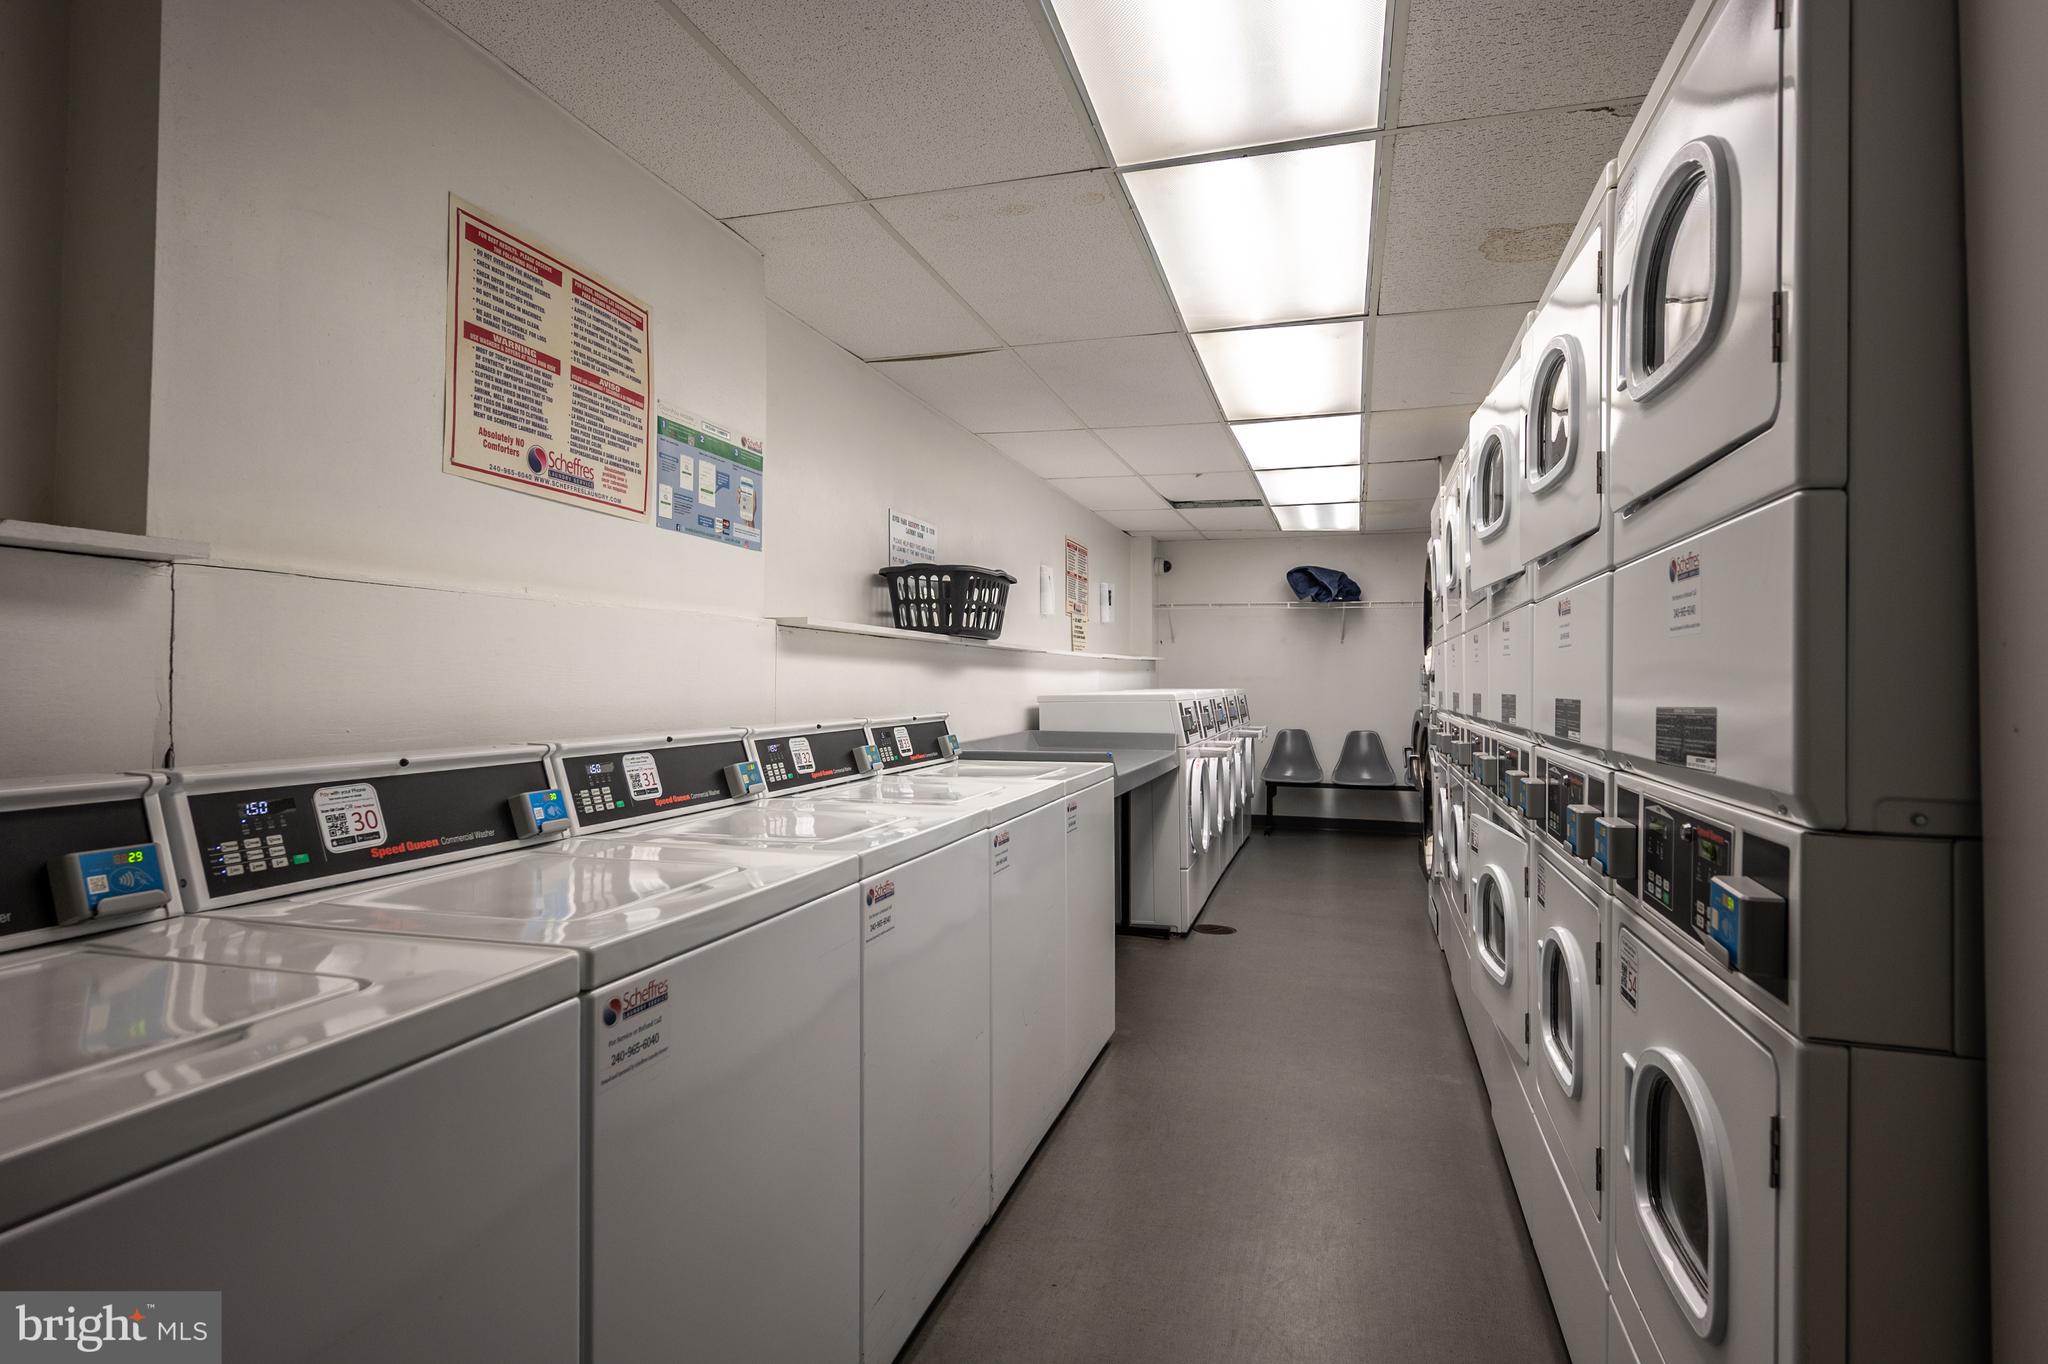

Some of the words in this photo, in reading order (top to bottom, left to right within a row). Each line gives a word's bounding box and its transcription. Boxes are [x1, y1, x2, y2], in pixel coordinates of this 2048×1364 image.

[477, 249, 483, 257] DO
[484, 252, 492, 261] NOT
[493, 257, 515, 272] OVERLOAD
[520, 252, 534, 265] PLEASE
[477, 259, 490, 270] CHECK
[492, 266, 505, 278] WATER
[506, 273, 534, 292] TEMPERATURE
[477, 269, 490, 280] CHECK
[491, 276, 504, 287] DRYER
[506, 283, 515, 293] HEAT
[476, 277, 482, 285] NO
[484, 280, 499, 293] DYEING
[506, 290, 523, 304] CLOTHES
[476, 287, 482, 295] DO
[483, 290, 492, 299] NOT
[493, 295, 504, 305] WASH
[476, 297, 492, 310] PLEASE
[493, 305, 505, 316] LEAVE
[506, 311, 526, 325] MACHINES
[476, 308, 483, 316] WE
[484, 311, 492, 320] ARE
[493, 315, 501, 324] NOT
[502, 319, 528, 336] RESPONSIBLE
[483, 318, 501, 330] DAMAGE
[493, 334, 537, 359] WARNING
[475, 361, 496, 375] DAMAGED
[503, 372, 523, 385] IMPROPER
[476, 345, 488, 356] MOST
[513, 360, 533, 373] GARMENTS
[542, 372, 552, 381] MADE
[482, 356, 504, 370] SYNTHETIC
[506, 365, 524, 378] MATERIAL
[525, 373, 533, 381] AND
[475, 370, 494, 382] CLOTHES
[495, 377, 512, 389] WASHED
[518, 386, 531, 396] WATER
[532, 391, 540, 399] THAT
[484, 381, 490, 389] OR
[491, 384, 502, 393] OVER
[600, 378, 621, 393] AVISO
[474, 394, 483, 403] ANY
[484, 397, 494, 406] LOSS
[502, 403, 520, 415] DAMAGE
[526, 411, 544, 423] CLOTHING
[474, 402, 483, 411] NOT
[492, 408, 525, 425] RESPONSIBILITY
[507, 397, 513, 405] OR
[514, 400, 529, 411] CHANGE
[474, 410, 486, 420] MENT
[494, 417, 518, 430] SCHEFFRES
[519, 425, 536, 436] LAUNDRY
[479, 427, 514, 445] Absolutely
[516, 439, 524, 447] NO
[483, 440, 520, 457] Comforters
[700, 435, 704, 443] 2
[549, 451, 594, 480] Scheffres
[489, 464, 532, 480] 240-965-6040
[534, 476, 621, 504] WWW.SCHEFFRESLAUNDRY.COM
[573, 477, 594, 488] SERVICE
[1678, 552, 1699, 575] Scheffres
[801, 752, 812, 764] 32
[642, 772, 657, 787] 31
[655, 797, 673, 807] Speed
[673, 793, 690, 803] Queen
[691, 791, 708, 799] Commercial
[352, 810, 378, 831] 30
[371, 843, 405, 859] Speed
[406, 838, 439, 851] Queen
[441, 833, 474, 846] Commercial
[474, 829, 495, 840] Washer
[128, 851, 143, 863] 29
[875, 880, 894, 897] Scheffres
[623, 980, 668, 1010] Scheffres
[610, 1032, 659, 1066] 240-965-6040
